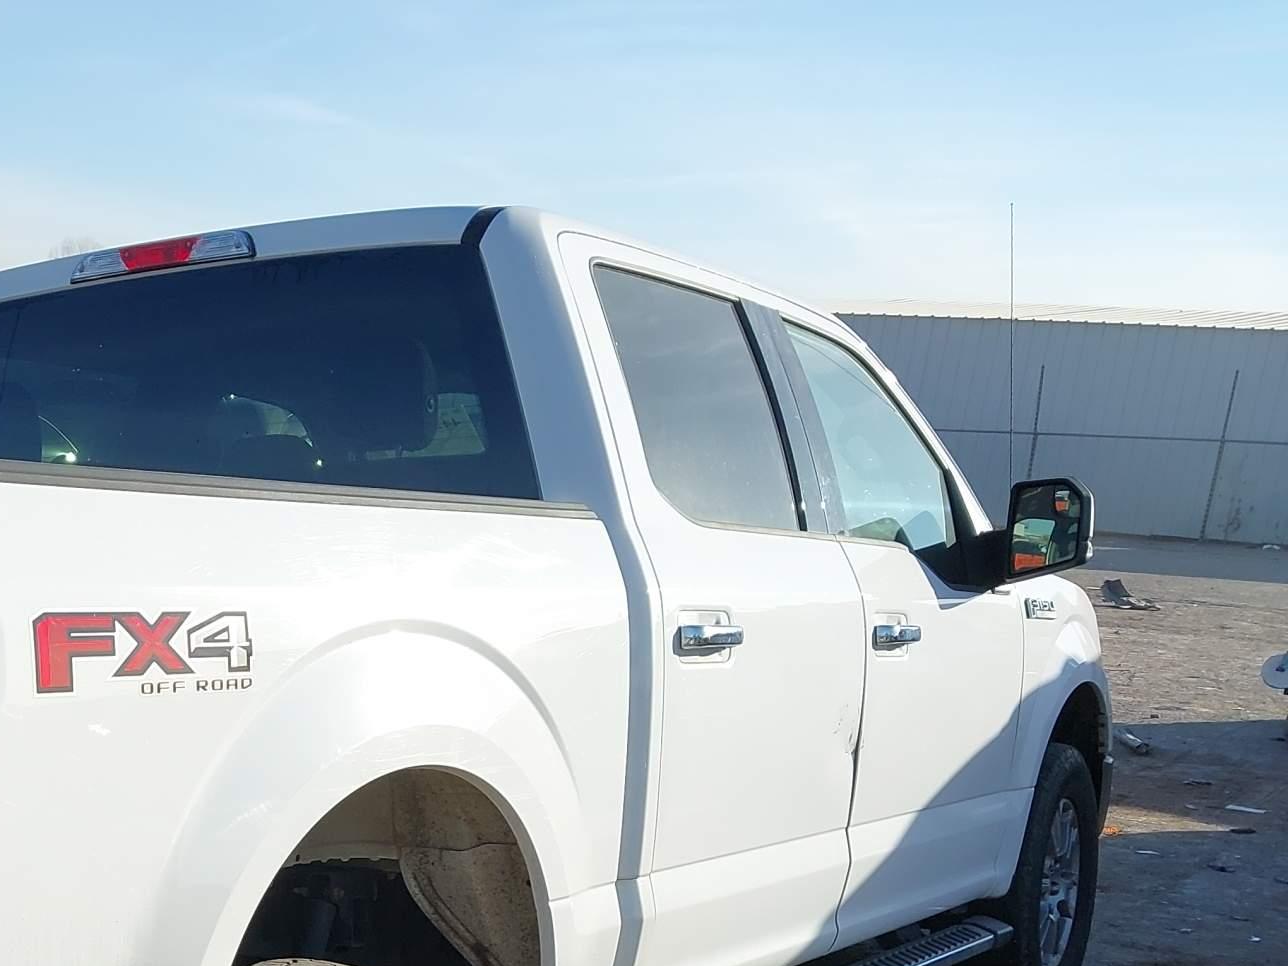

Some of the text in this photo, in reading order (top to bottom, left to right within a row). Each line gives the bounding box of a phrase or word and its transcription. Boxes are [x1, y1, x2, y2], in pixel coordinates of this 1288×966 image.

[32, 611, 253, 694] FX4
[141, 678, 252, 695] OFF ROAD
